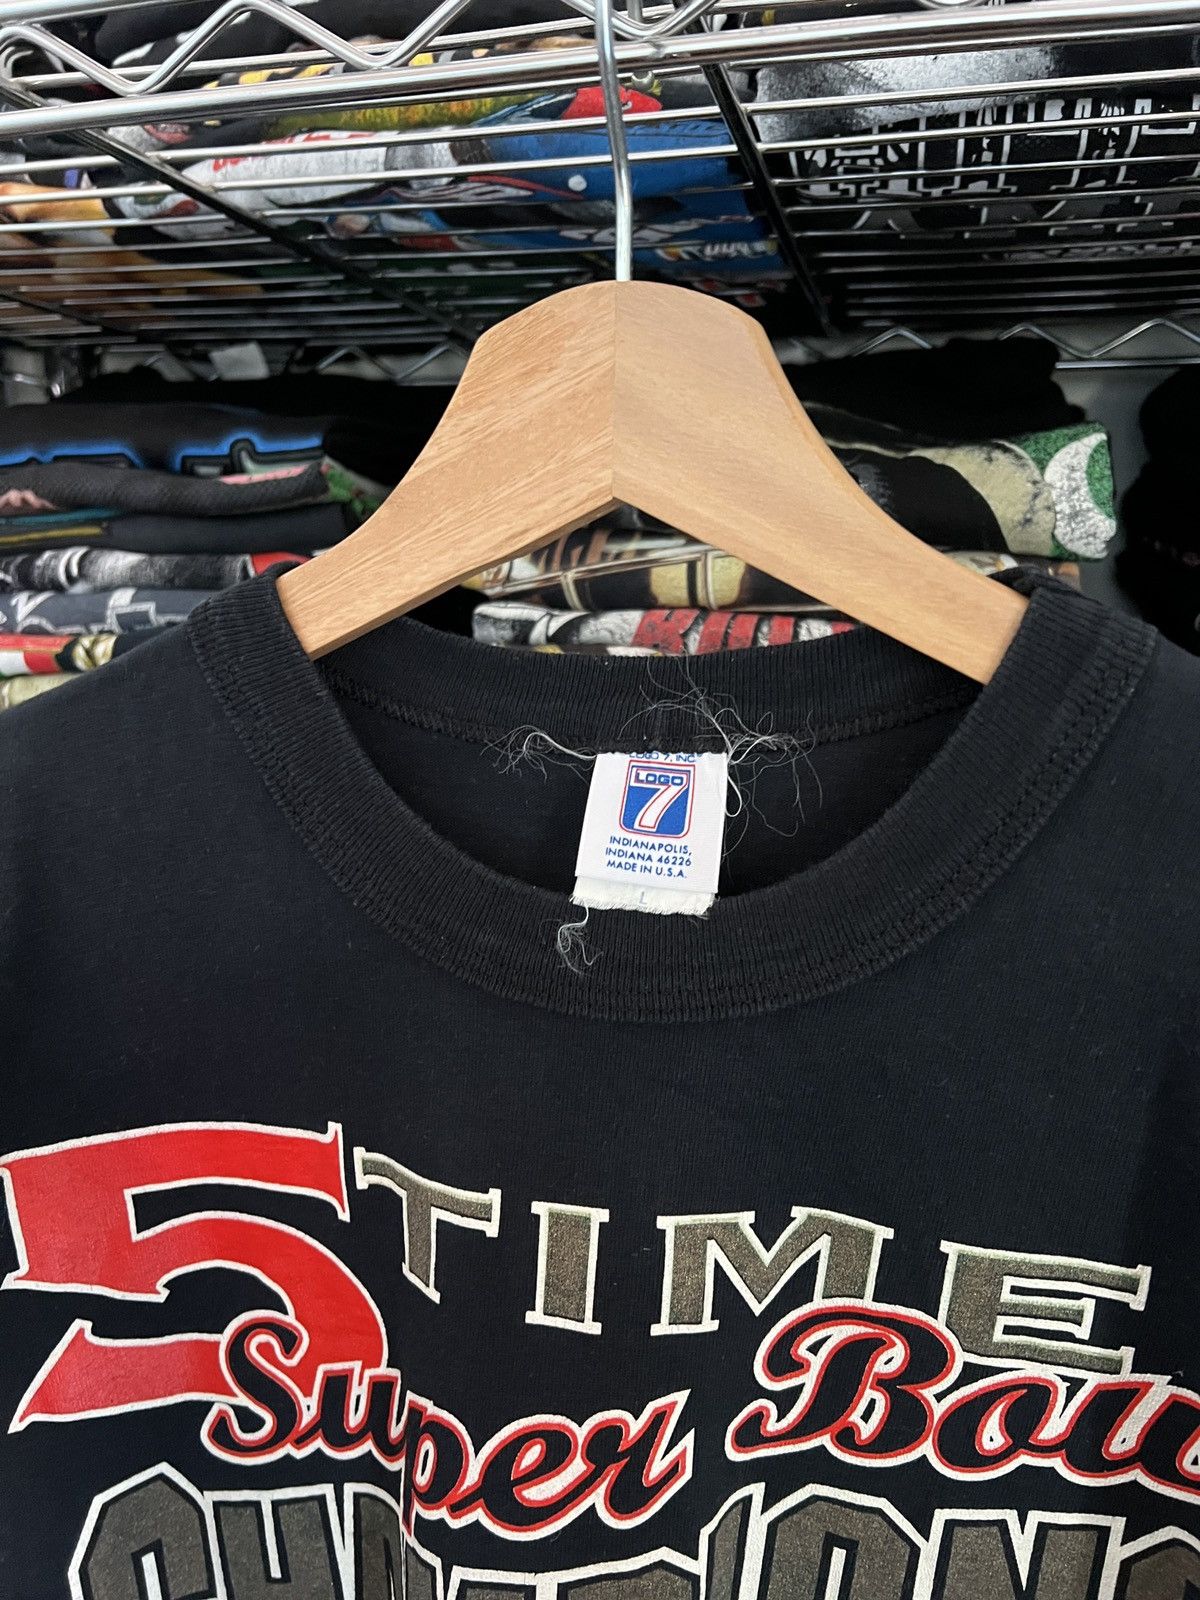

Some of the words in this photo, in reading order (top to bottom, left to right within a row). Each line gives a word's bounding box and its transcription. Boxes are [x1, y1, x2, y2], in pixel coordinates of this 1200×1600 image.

[630, 766, 691, 833] 7
[634, 770, 684, 787] LOGO
[605, 847, 653, 863] INDIANA
[657, 855, 692, 867] 46226
[609, 836, 692, 856] INDIANAPOLIS,
[606, 860, 638, 872] MADE
[640, 865, 653, 874] IN
[655, 867, 688, 879] U.S.A.
[0, 1121, 388, 1434] 5
[353, 1146, 1152, 1376] TIME
[201, 1309, 695, 1543] Super
